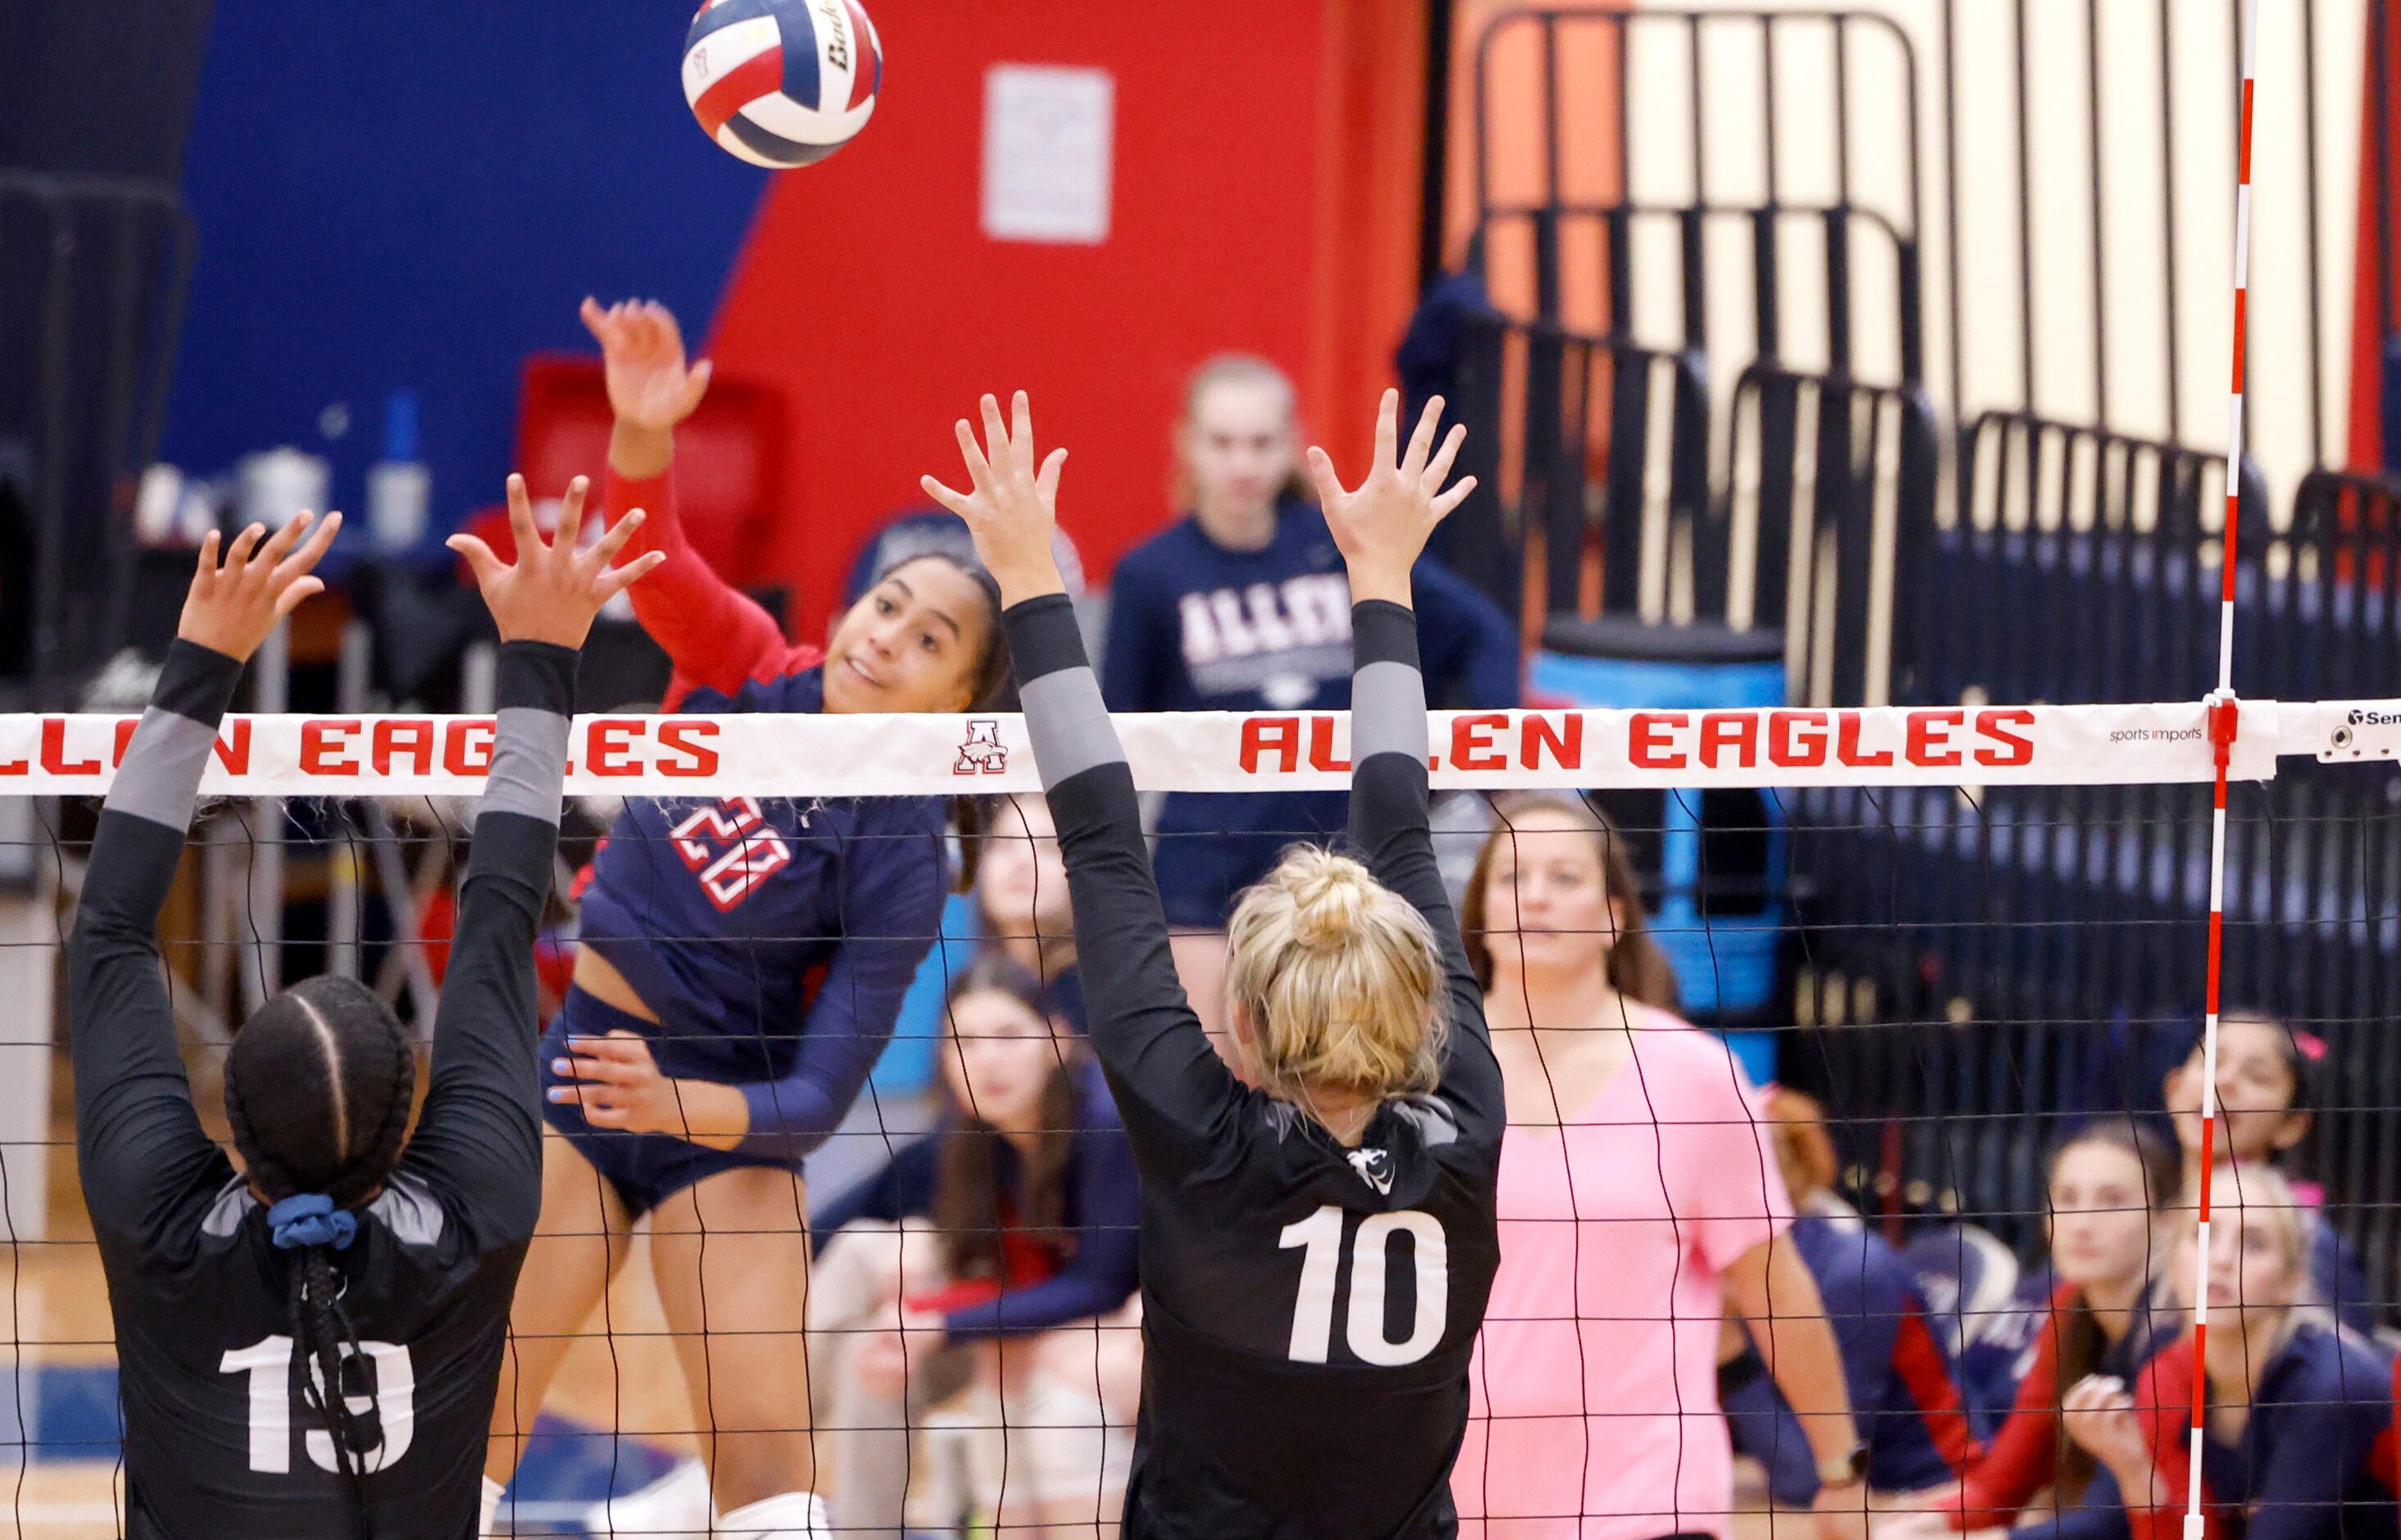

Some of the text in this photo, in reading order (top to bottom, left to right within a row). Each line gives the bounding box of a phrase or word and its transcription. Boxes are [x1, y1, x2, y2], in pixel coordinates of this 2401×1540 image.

[299, 719, 720, 777] EAGES
[1239, 710, 2035, 774] ALEN EAGLES
[2110, 728, 2202, 744] sports imports
[1278, 1205, 1449, 1368] 10
[219, 1334, 415, 1475] 19
